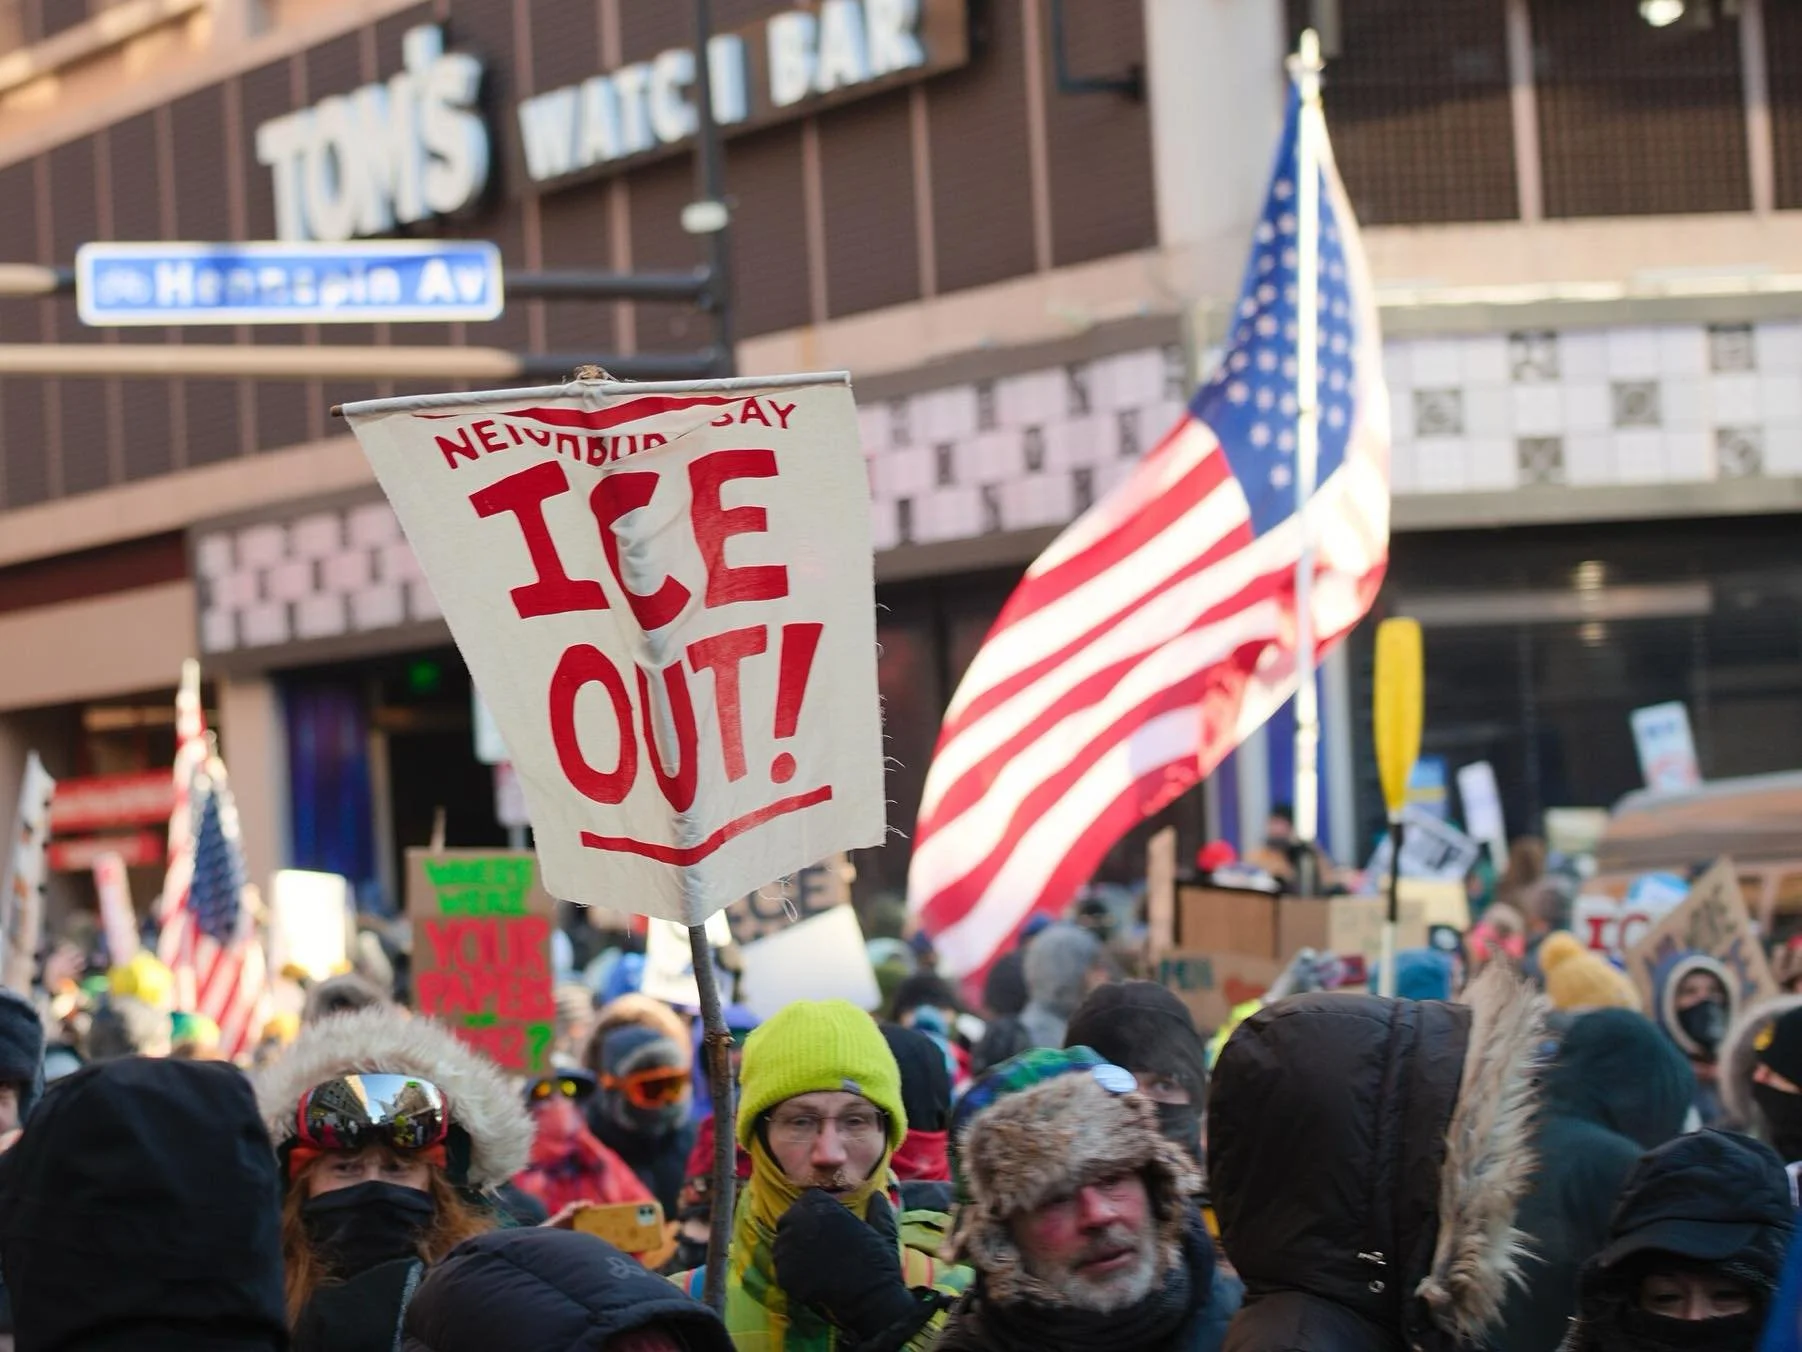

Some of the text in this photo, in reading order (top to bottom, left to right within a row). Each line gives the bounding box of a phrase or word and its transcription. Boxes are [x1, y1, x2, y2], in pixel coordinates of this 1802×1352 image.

[257, 24, 488, 240] TOM'S
[766, 0, 924, 107] BAR
[469, 449, 789, 632] ICE
[549, 622, 825, 813] OUT!
[425, 916, 550, 974] YOUR
